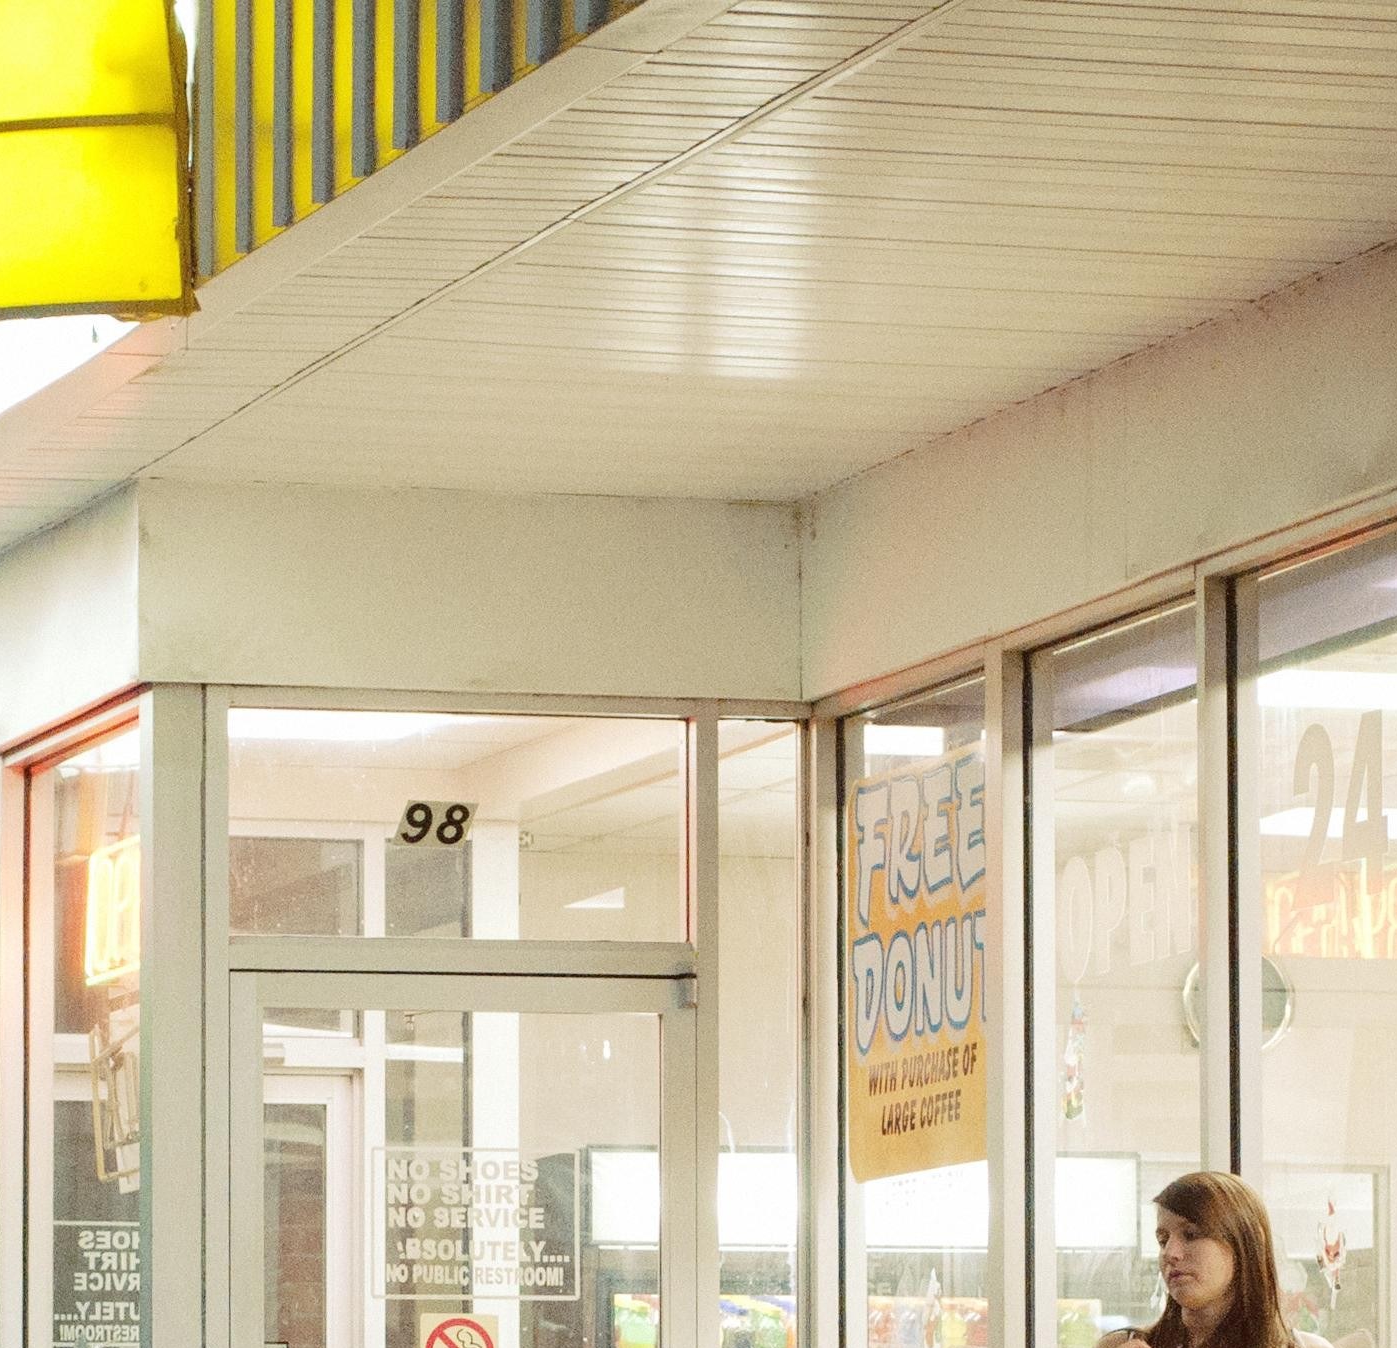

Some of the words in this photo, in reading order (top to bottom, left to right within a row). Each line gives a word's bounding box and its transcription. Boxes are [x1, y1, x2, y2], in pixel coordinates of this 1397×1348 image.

[399, 801, 471, 846] 98
[1292, 708, 1389, 911] 24
[854, 752, 985, 929] FREE
[868, 1059, 897, 1096] WITH
[901, 1046, 959, 1090] PURCHASE
[962, 1042, 978, 1076] OF
[881, 1104, 916, 1136] LARGE
[919, 1089, 962, 1128] COFFEE
[387, 1159, 430, 1181] NO
[439, 1160, 539, 1182] SHOES
[387, 1183, 431, 1205] NO
[440, 1184, 535, 1206] SHIRT
[387, 1207, 426, 1229] NO
[433, 1207, 545, 1229] SERVICE
[386, 1264, 408, 1283] NO
[412, 1265, 470, 1285] PUBLIC
[475, 1267, 564, 1287] RESTROOM!
